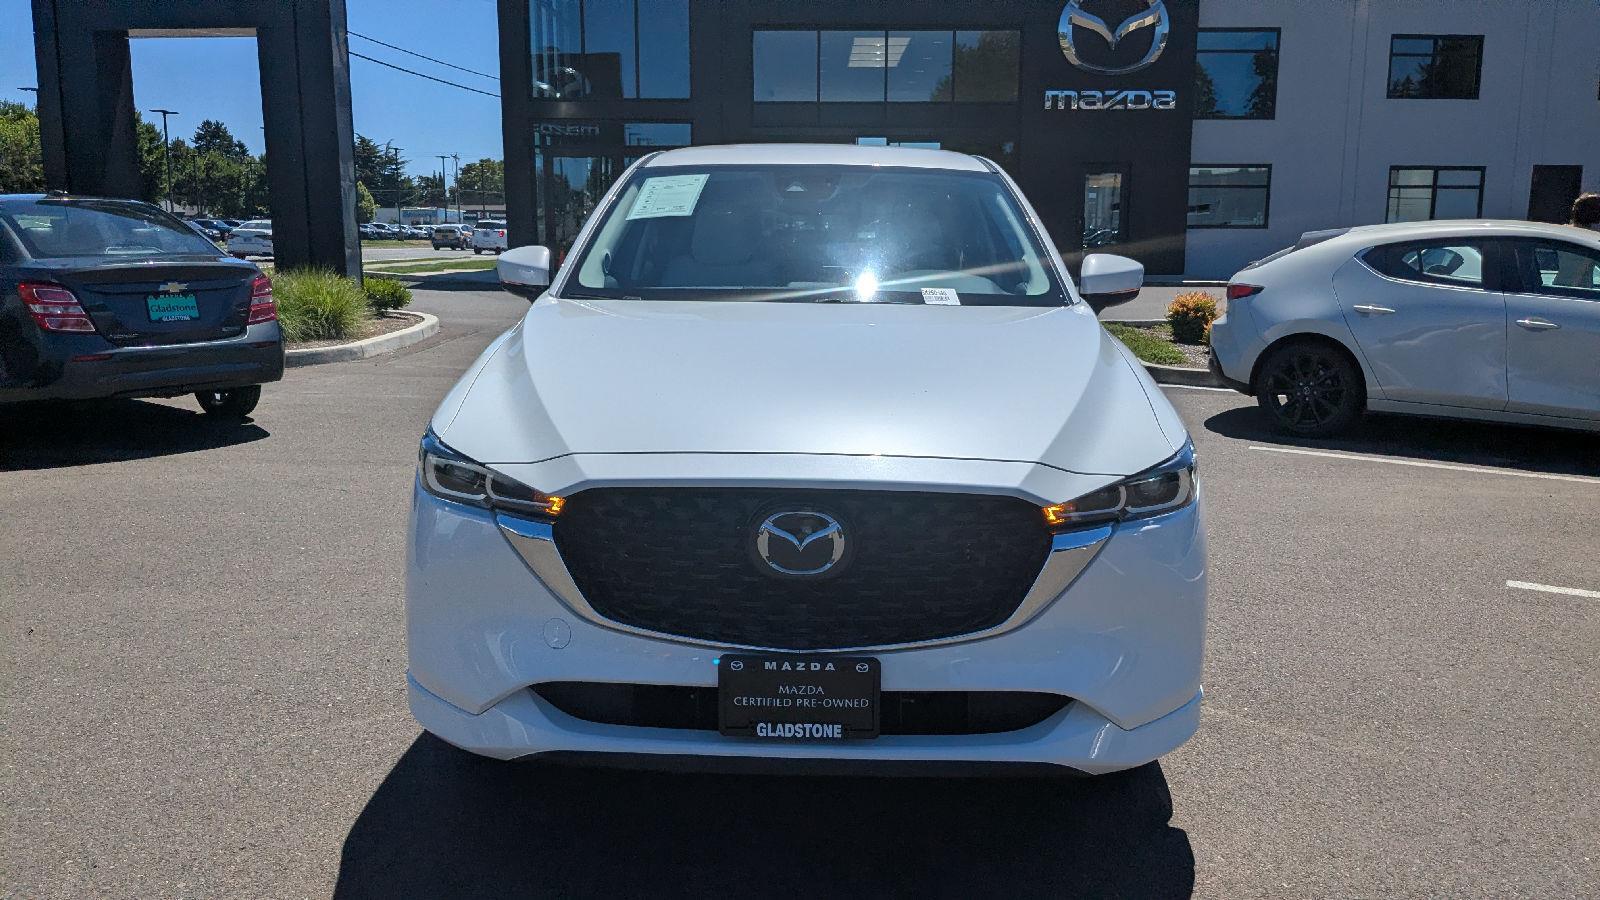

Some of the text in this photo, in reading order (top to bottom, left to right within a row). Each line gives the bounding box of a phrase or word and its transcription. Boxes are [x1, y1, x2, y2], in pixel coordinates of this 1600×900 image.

[150, 304, 197, 312] Gladstone
[764, 661, 836, 671] MAZDA
[778, 685, 825, 695] MAZDA
[733, 696, 869, 708] CERTIFIED PRE-OWNED
[756, 722, 842, 738] GLADSTONE
